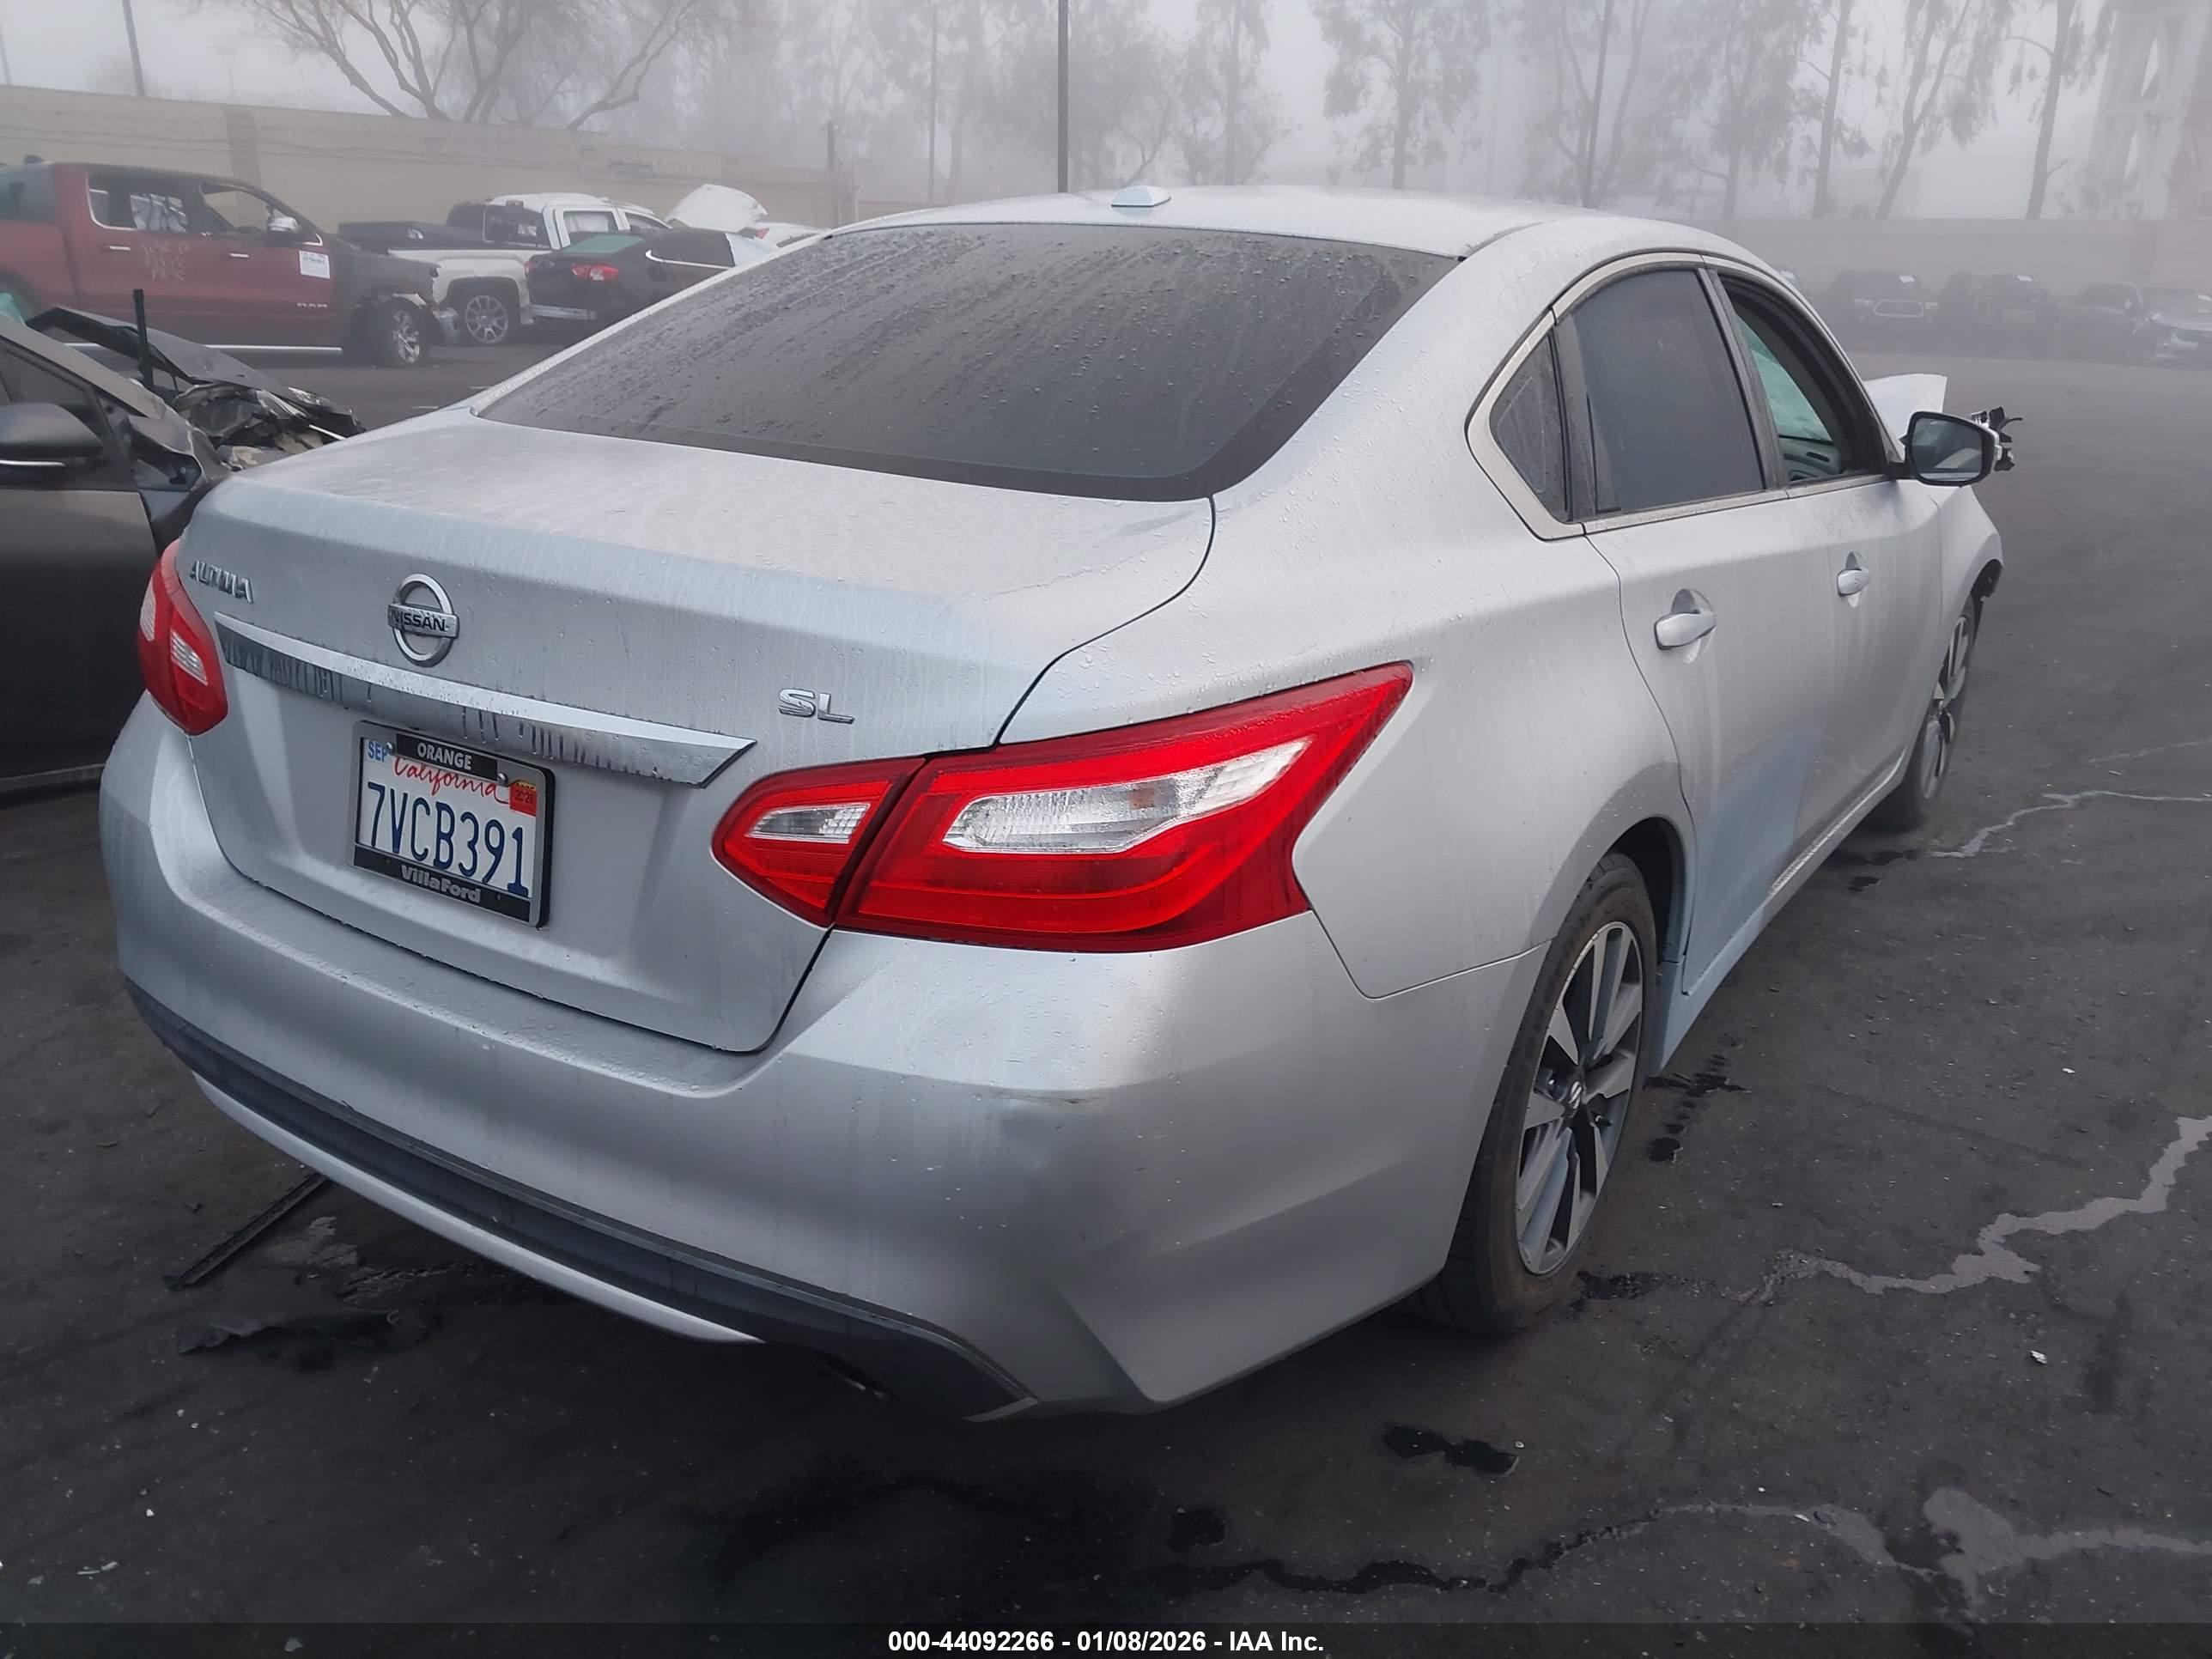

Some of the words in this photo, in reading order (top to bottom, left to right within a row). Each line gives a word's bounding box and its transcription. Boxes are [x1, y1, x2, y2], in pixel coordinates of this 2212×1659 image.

[391, 608, 446, 631] NISSAN
[778, 688, 855, 724] SL
[416, 742, 472, 770] ORANGE
[393, 757, 509, 805] California
[368, 781, 529, 897] 7VCB391
